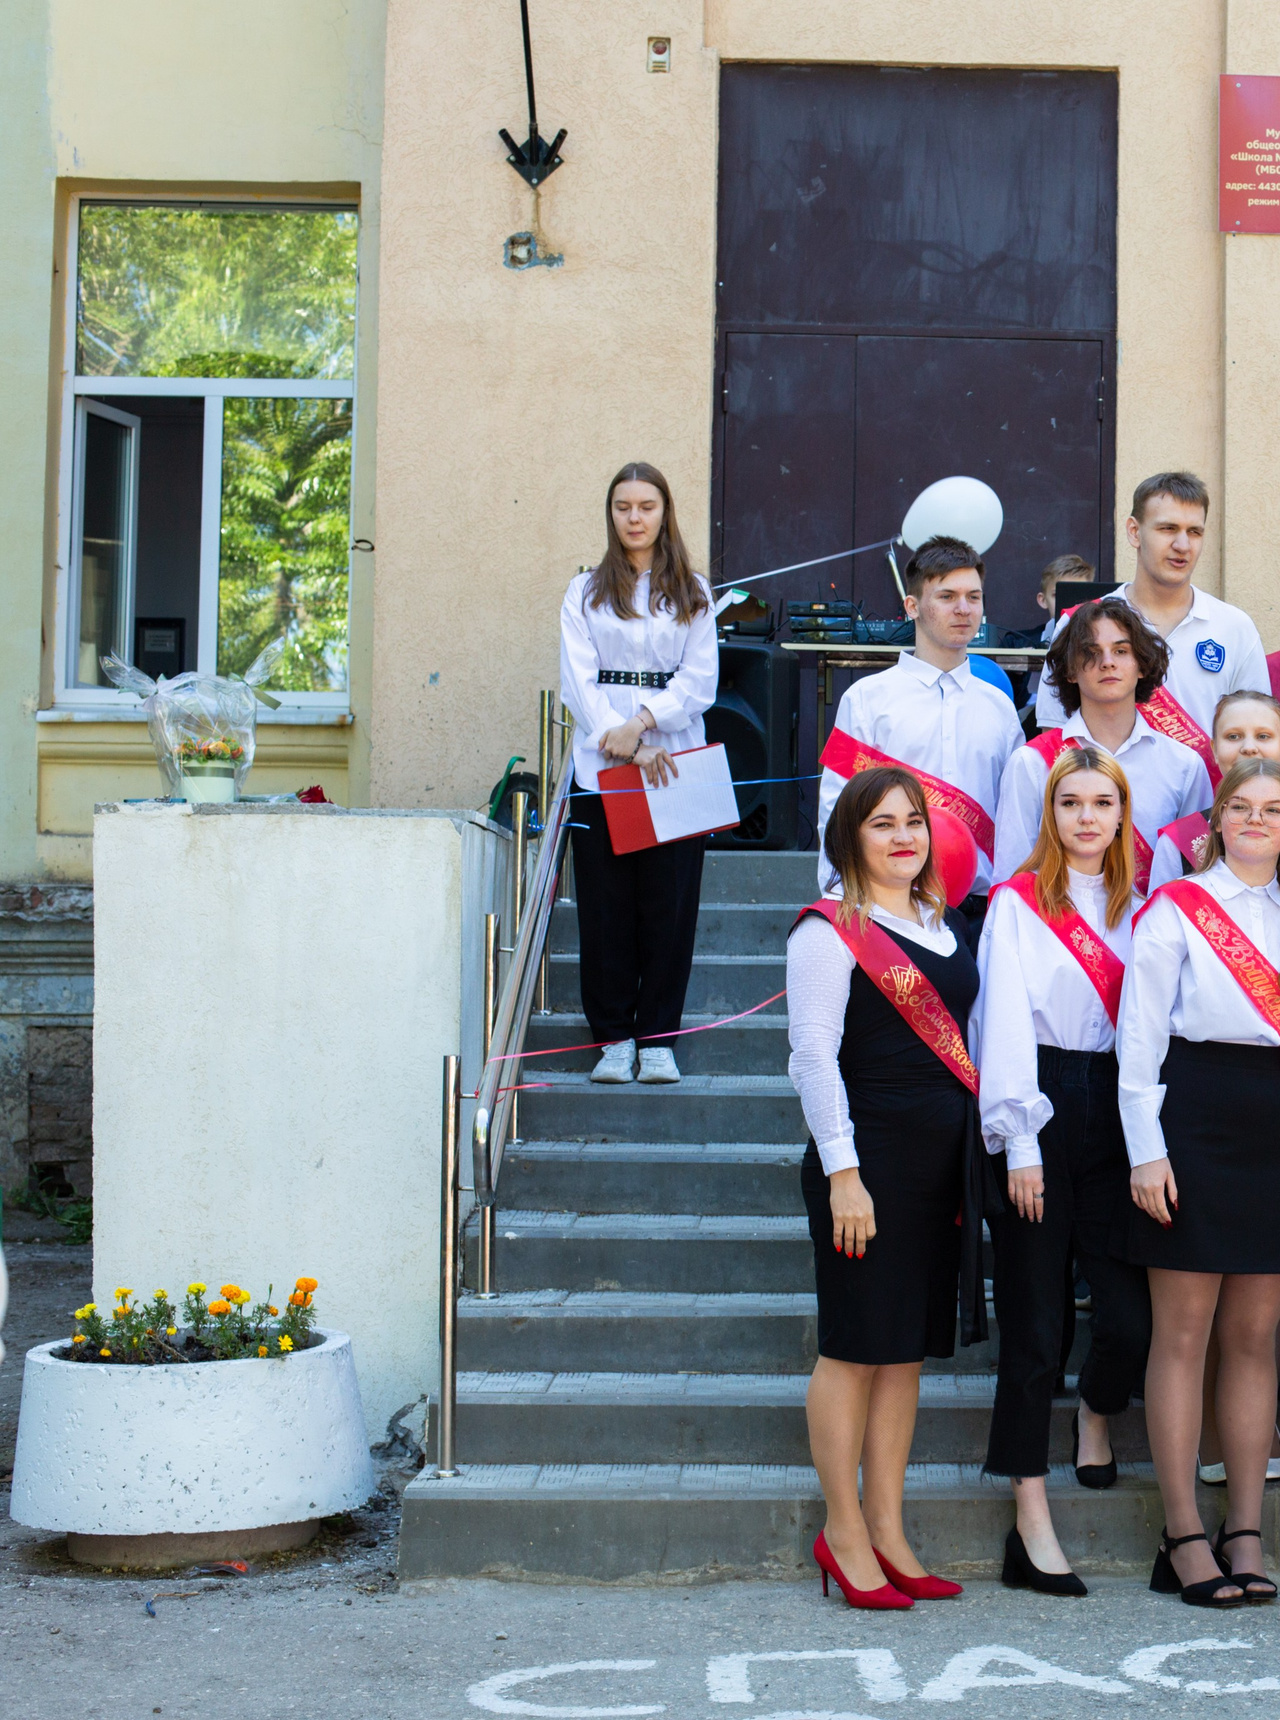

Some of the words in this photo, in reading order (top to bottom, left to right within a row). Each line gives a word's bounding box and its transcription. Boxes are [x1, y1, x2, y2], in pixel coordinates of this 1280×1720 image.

[1230, 152, 1273, 162] «Школа
[1226, 182, 1256, 191] адрес:
[1248, 198, 1279, 207] режим
